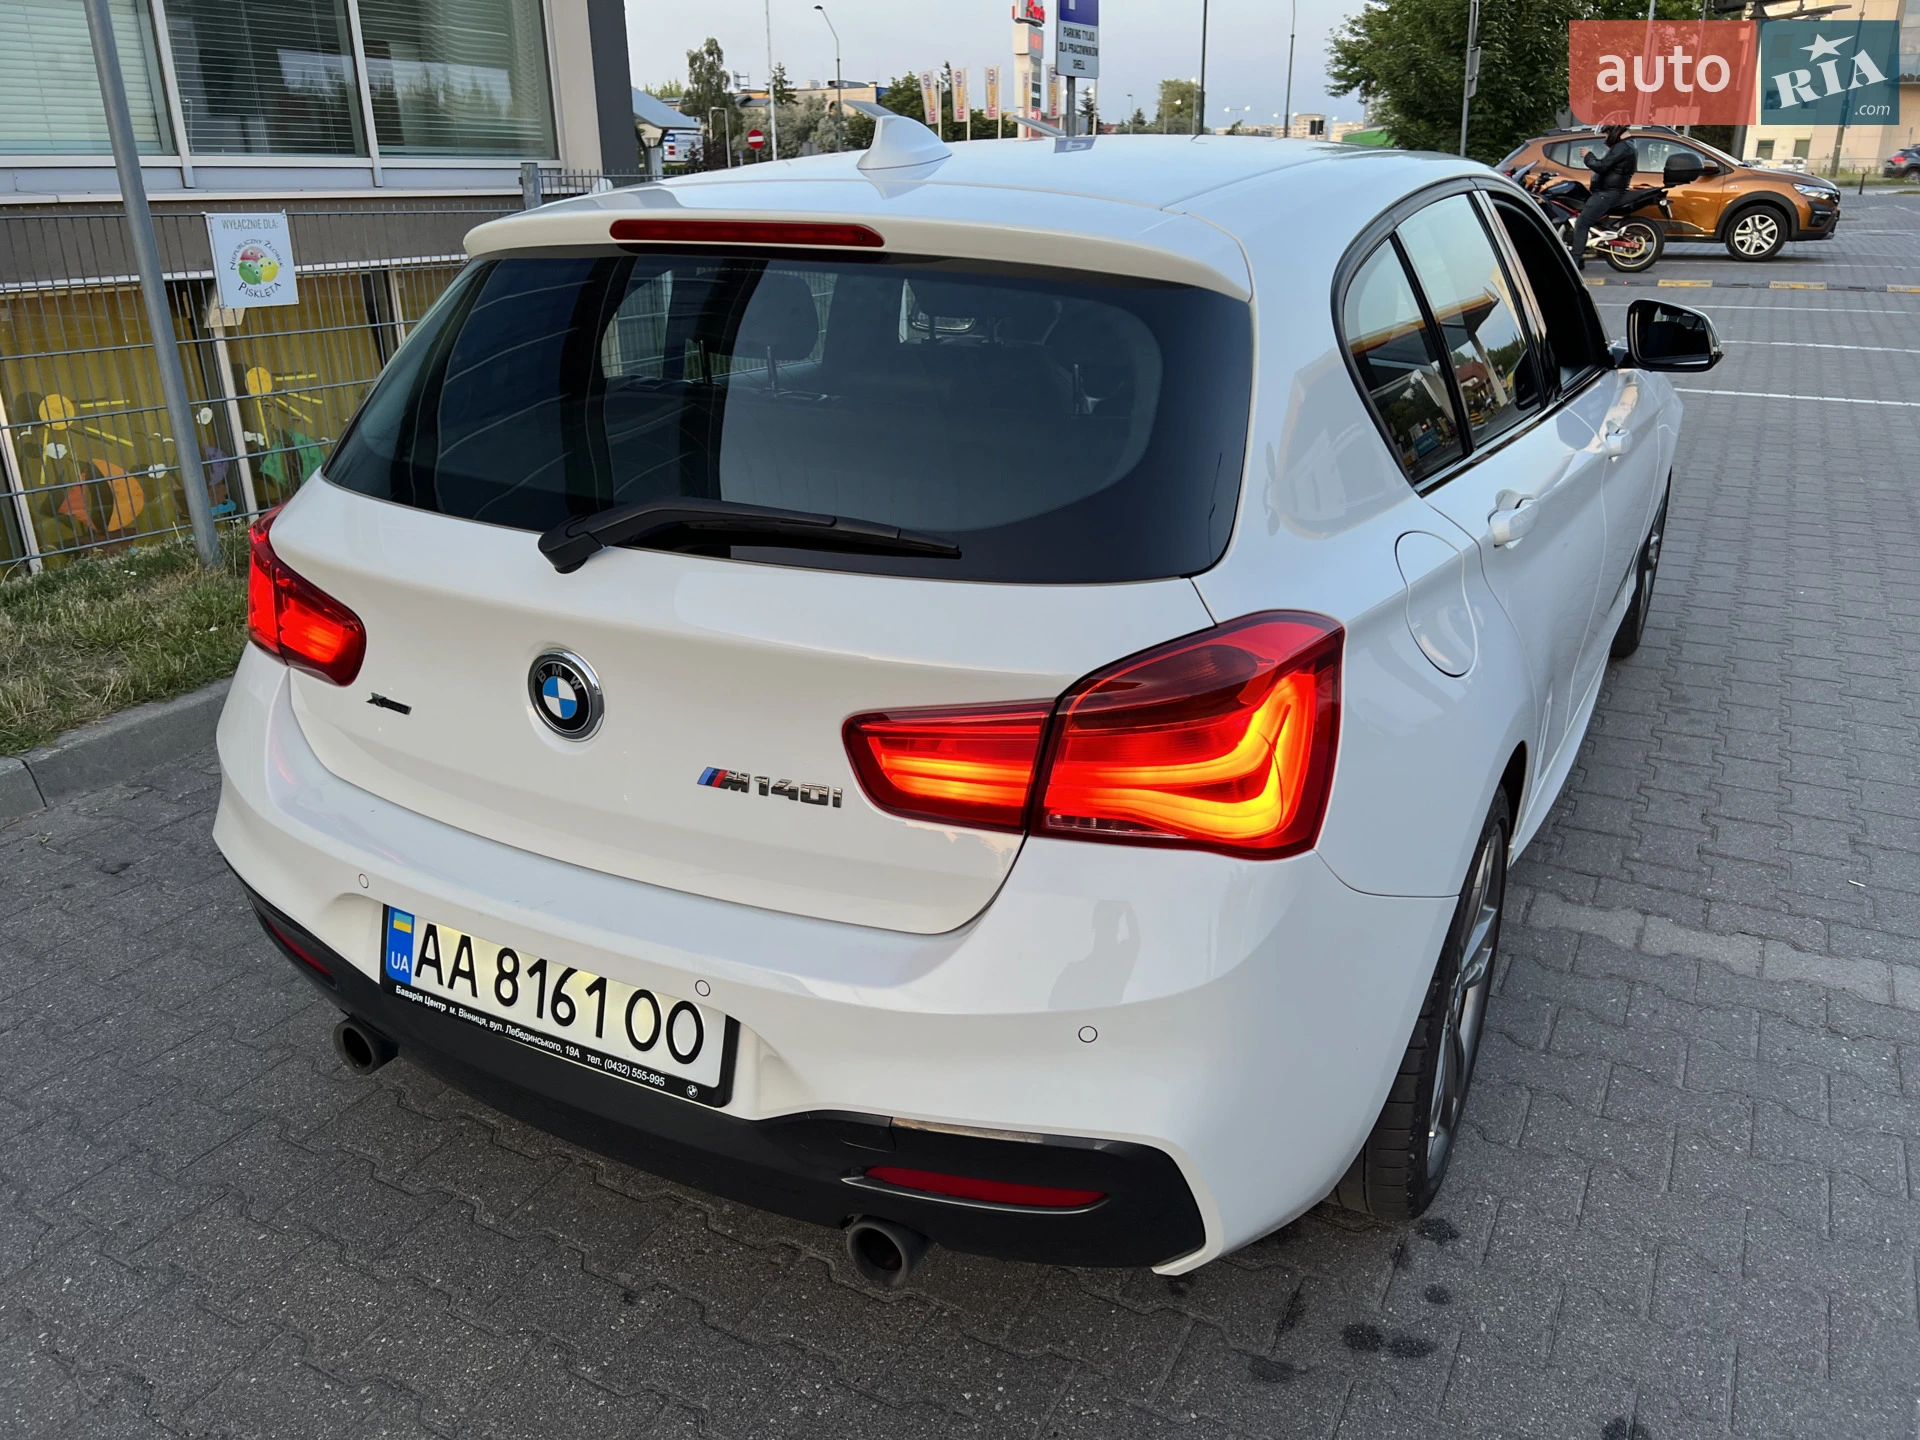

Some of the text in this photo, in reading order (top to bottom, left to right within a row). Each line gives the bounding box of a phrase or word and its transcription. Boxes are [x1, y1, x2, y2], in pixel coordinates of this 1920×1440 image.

[222, 218, 261, 231] WYŁĄCZNIE
[537, 664, 583, 691] BMW
[391, 951, 410, 974] UA
[415, 923, 479, 998] AA
[494, 947, 607, 1039] 8161
[396, 985, 423, 1003] Баварія
[424, 995, 447, 1012] Центр
[449, 1006, 457, 1016] м.
[458, 1008, 488, 1027] Вінниця,
[489, 1021, 504, 1034] вул.
[505, 1024, 563, 1053] Лебединського,
[587, 1054, 602, 1066] тел.
[604, 1058, 631, 1077] (0432)
[631, 1067, 665, 1087] 555-995
